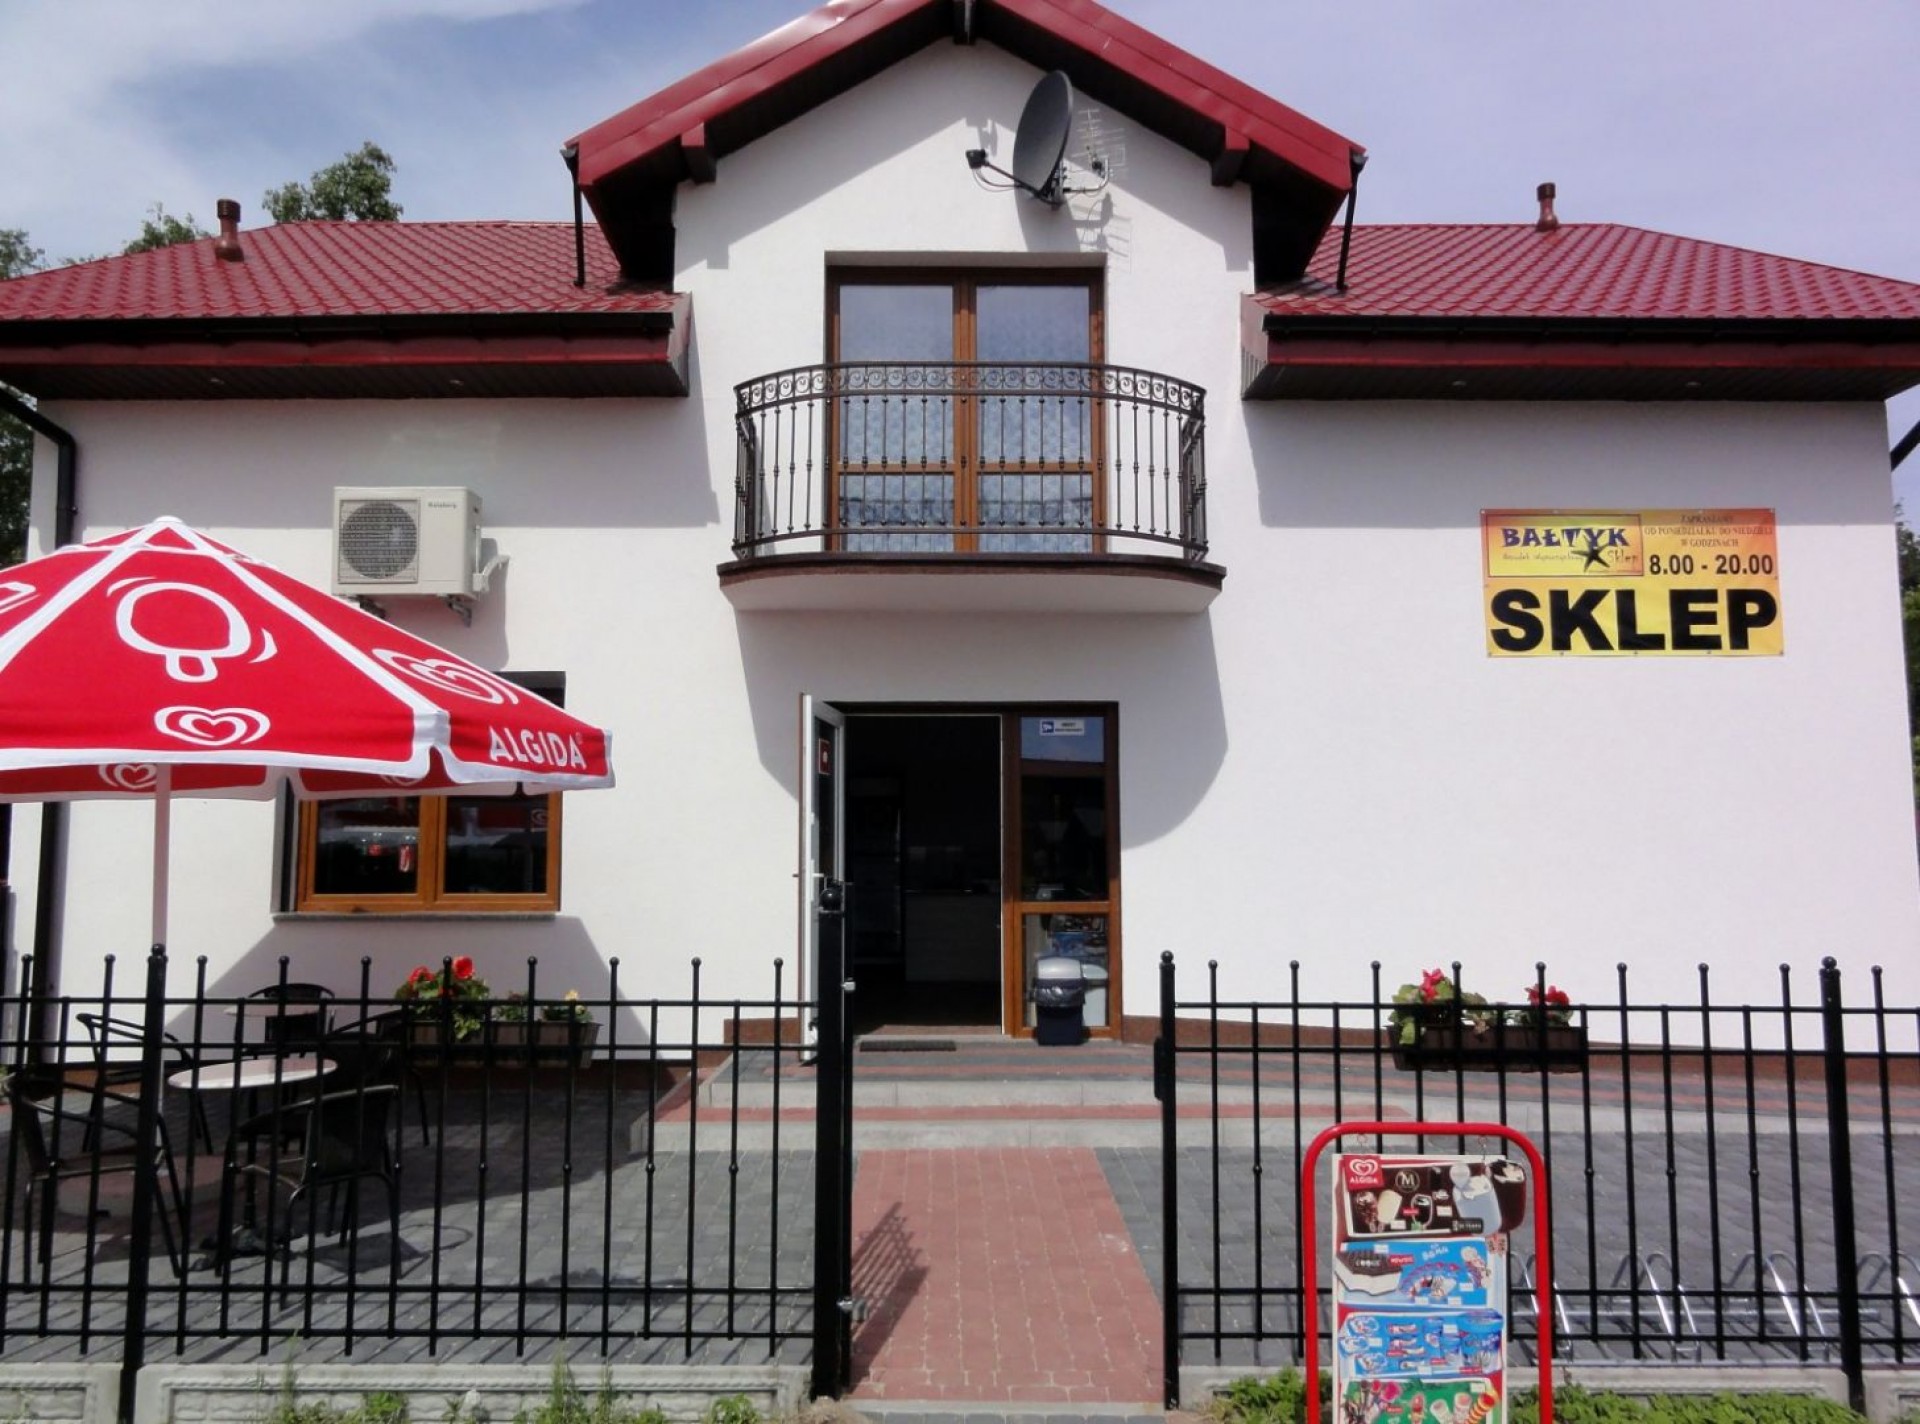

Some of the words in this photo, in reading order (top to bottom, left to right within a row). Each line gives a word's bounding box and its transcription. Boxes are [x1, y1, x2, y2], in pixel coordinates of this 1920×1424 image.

[1502, 527, 1629, 547] BAŁTYK
[1649, 554, 1694, 575] 8.00
[1715, 554, 1773, 575] 20.00
[1491, 588, 1778, 652] SKLEP
[490, 726, 587, 770] ALGIDA
[1349, 1176, 1379, 1185] ALGIDA
